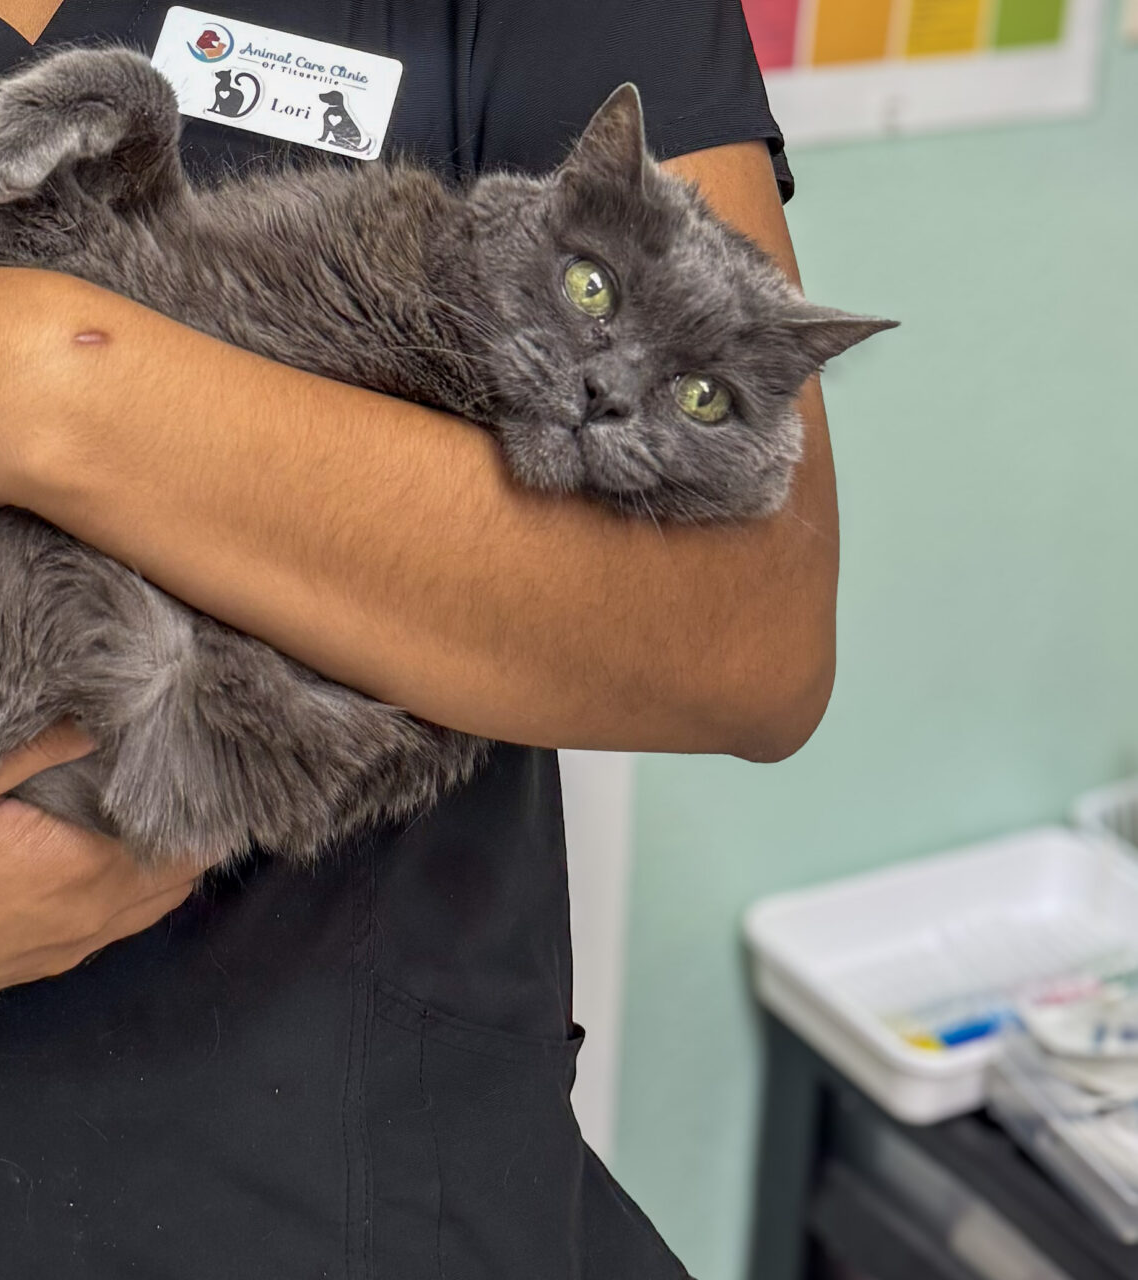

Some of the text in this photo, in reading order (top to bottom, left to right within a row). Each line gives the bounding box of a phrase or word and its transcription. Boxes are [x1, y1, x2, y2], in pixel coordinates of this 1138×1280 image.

[239, 42, 369, 84] Animal Care Clinic
[270, 98, 312, 120] Lori
